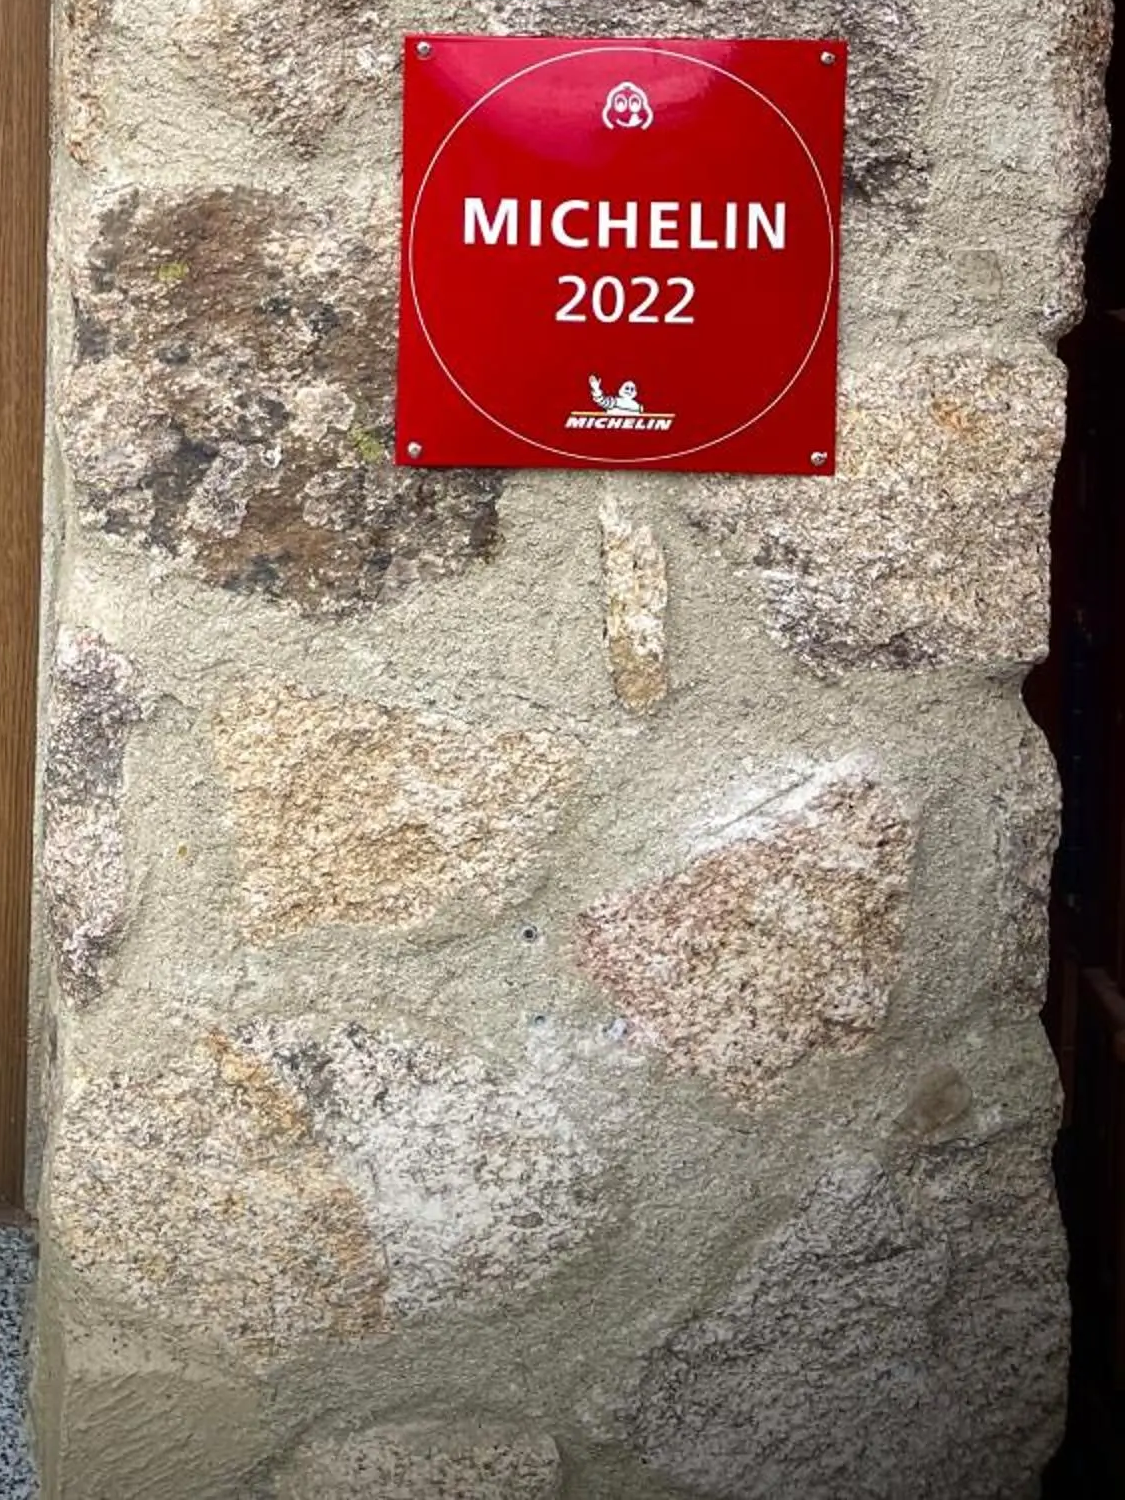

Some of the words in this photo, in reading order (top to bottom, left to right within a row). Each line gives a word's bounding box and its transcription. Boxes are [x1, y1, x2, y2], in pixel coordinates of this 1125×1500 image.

[463, 197, 786, 249] MICHELIN
[555, 276, 695, 324] 2022
[564, 416, 673, 430] MICHELIN
